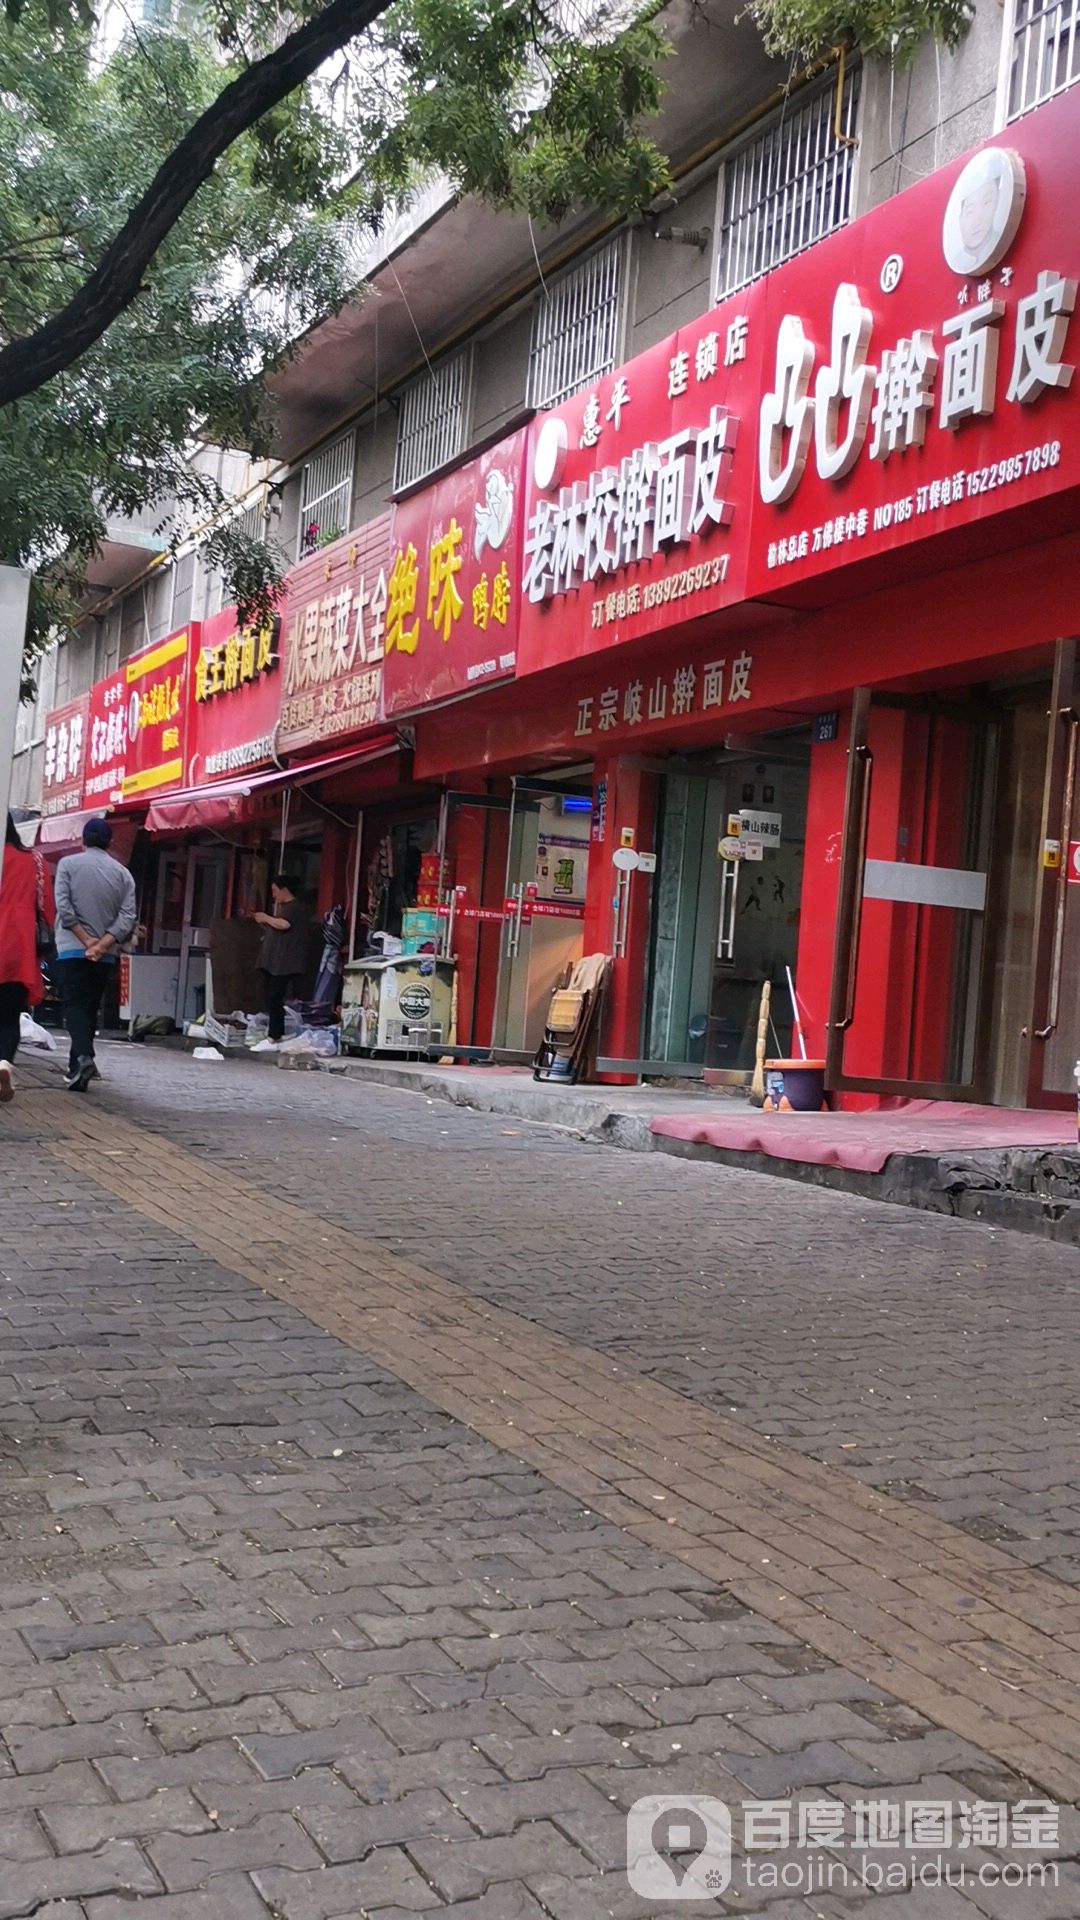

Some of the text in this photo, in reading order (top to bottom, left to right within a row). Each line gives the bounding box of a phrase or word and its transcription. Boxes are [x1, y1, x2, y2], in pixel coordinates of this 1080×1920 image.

[668, 315, 749, 400] 连锁店
[522, 404, 740, 603] 老林校擀面皮
[284, 567, 388, 696] 水果蔬菜大全
[385, 517, 511, 656] 绝味 鸭脖
[574, 650, 753, 737] 正宗岐山擀面皮
